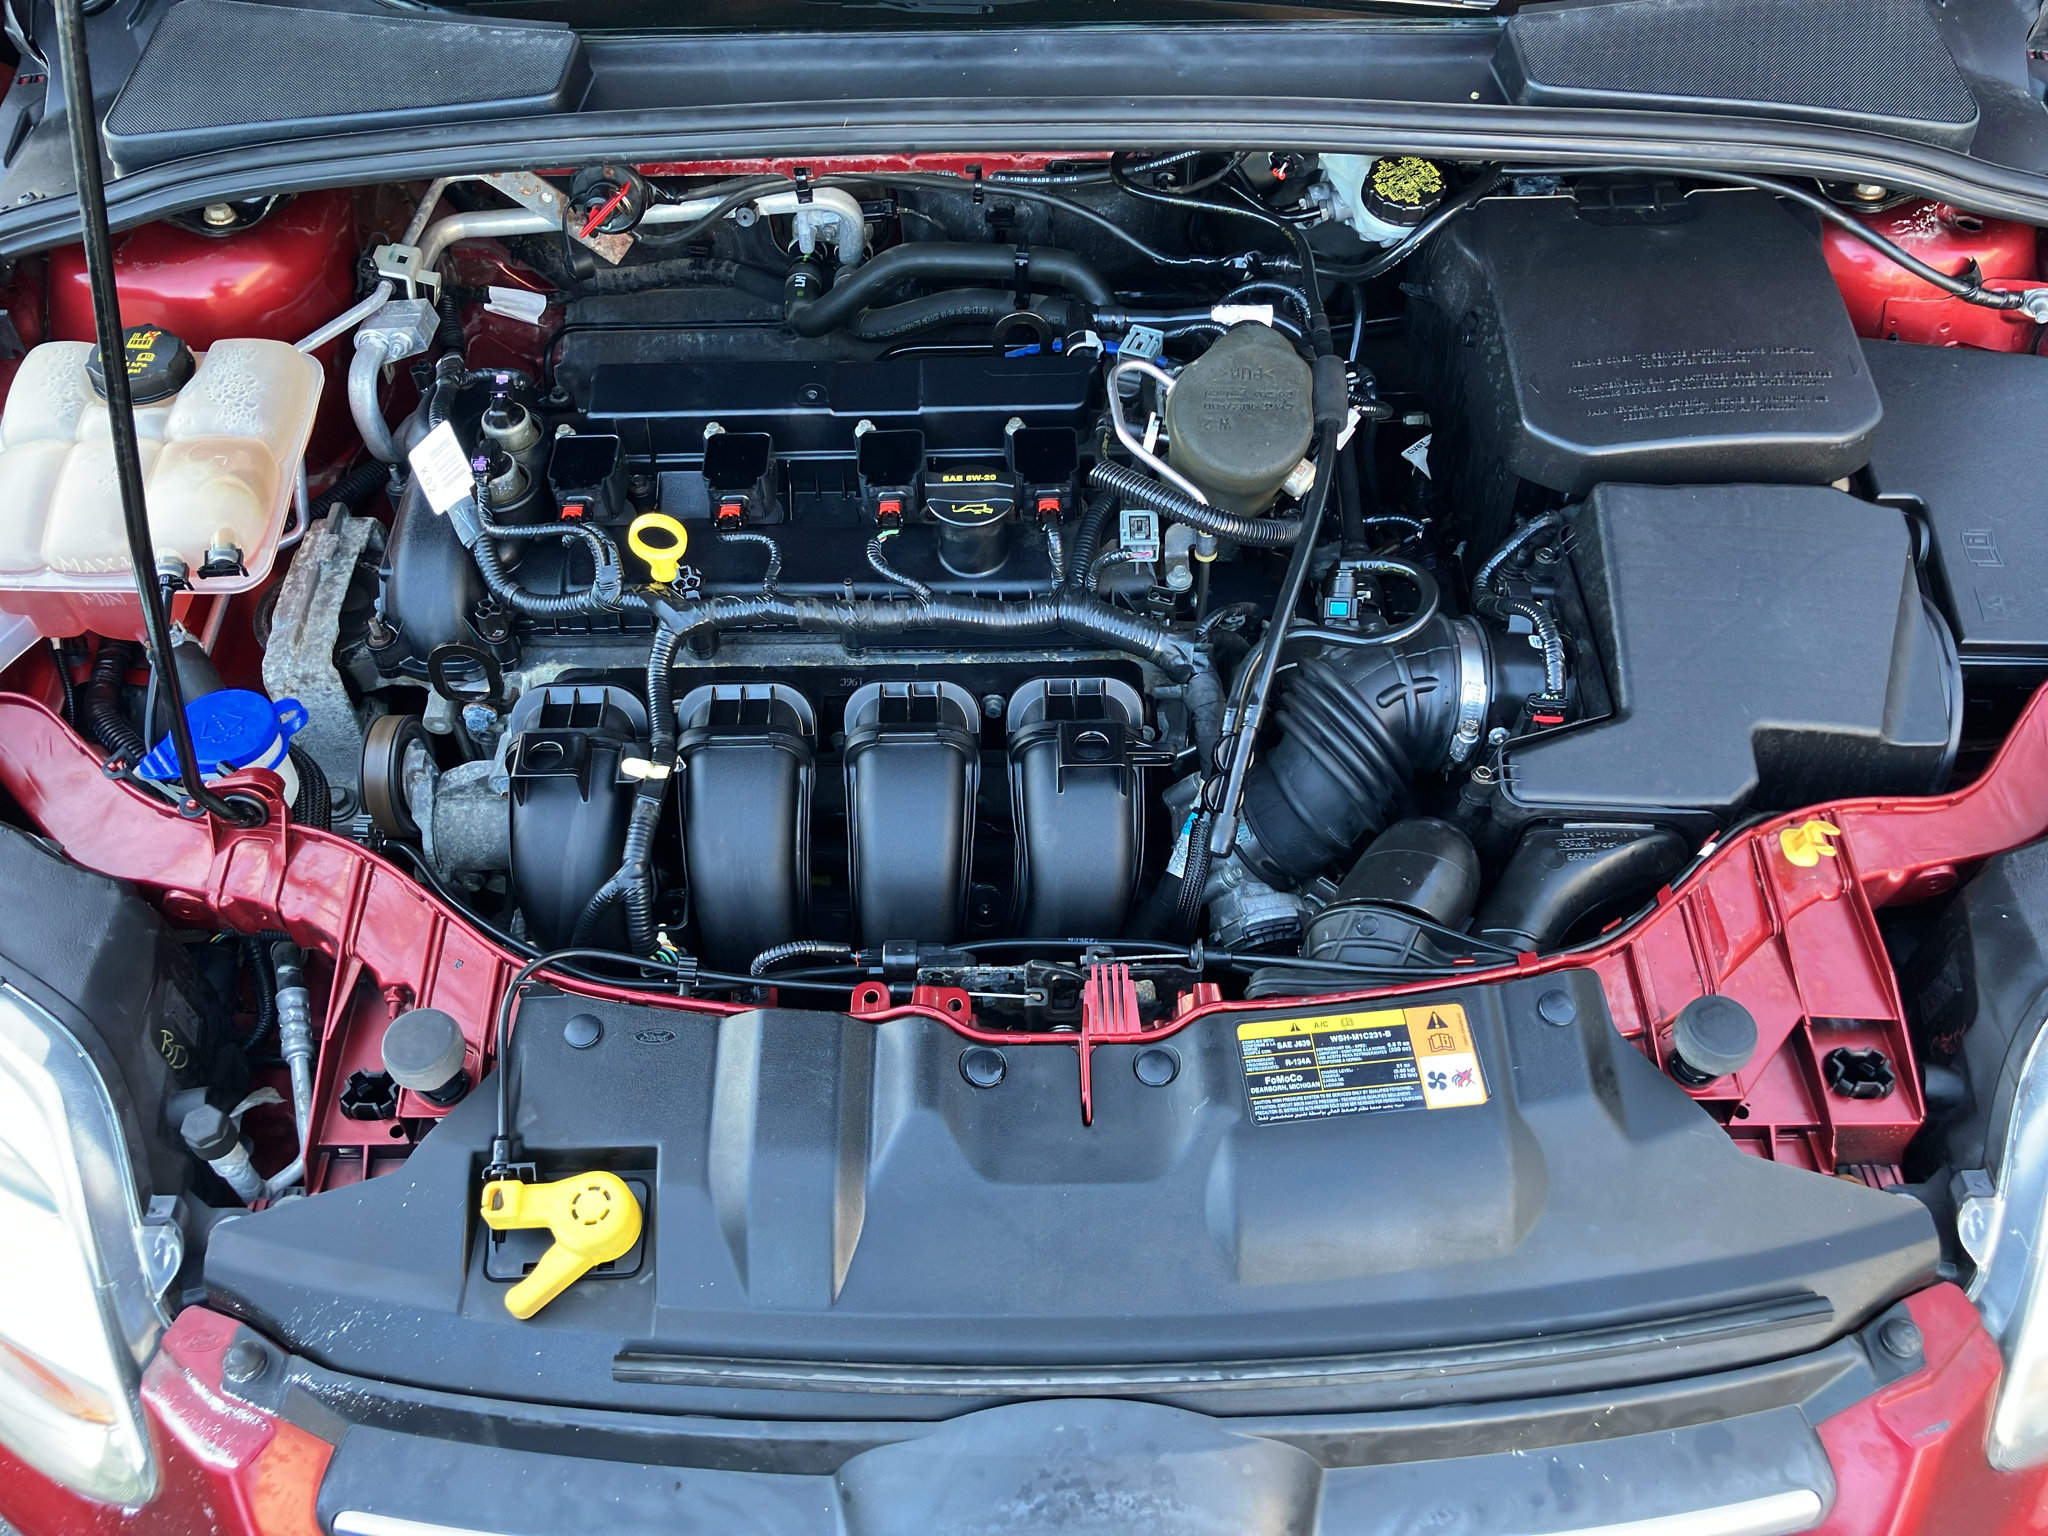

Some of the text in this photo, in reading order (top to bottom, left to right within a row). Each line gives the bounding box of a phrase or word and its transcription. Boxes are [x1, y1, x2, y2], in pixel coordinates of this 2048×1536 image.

[965, 473, 997, 482] 5W-20
[57, 556, 116, 574] MAX
[79, 592, 127, 607] MIN
[1329, 1029, 1391, 1042] WSH-M1C231-B
[1276, 1039, 1311, 1049] SAE J639
[1284, 1057, 1311, 1066] R-134A
[1264, 1072, 1303, 1085] FoMoCo
[1250, 1080, 1320, 1093] DEARBORN, MICHIGAN
